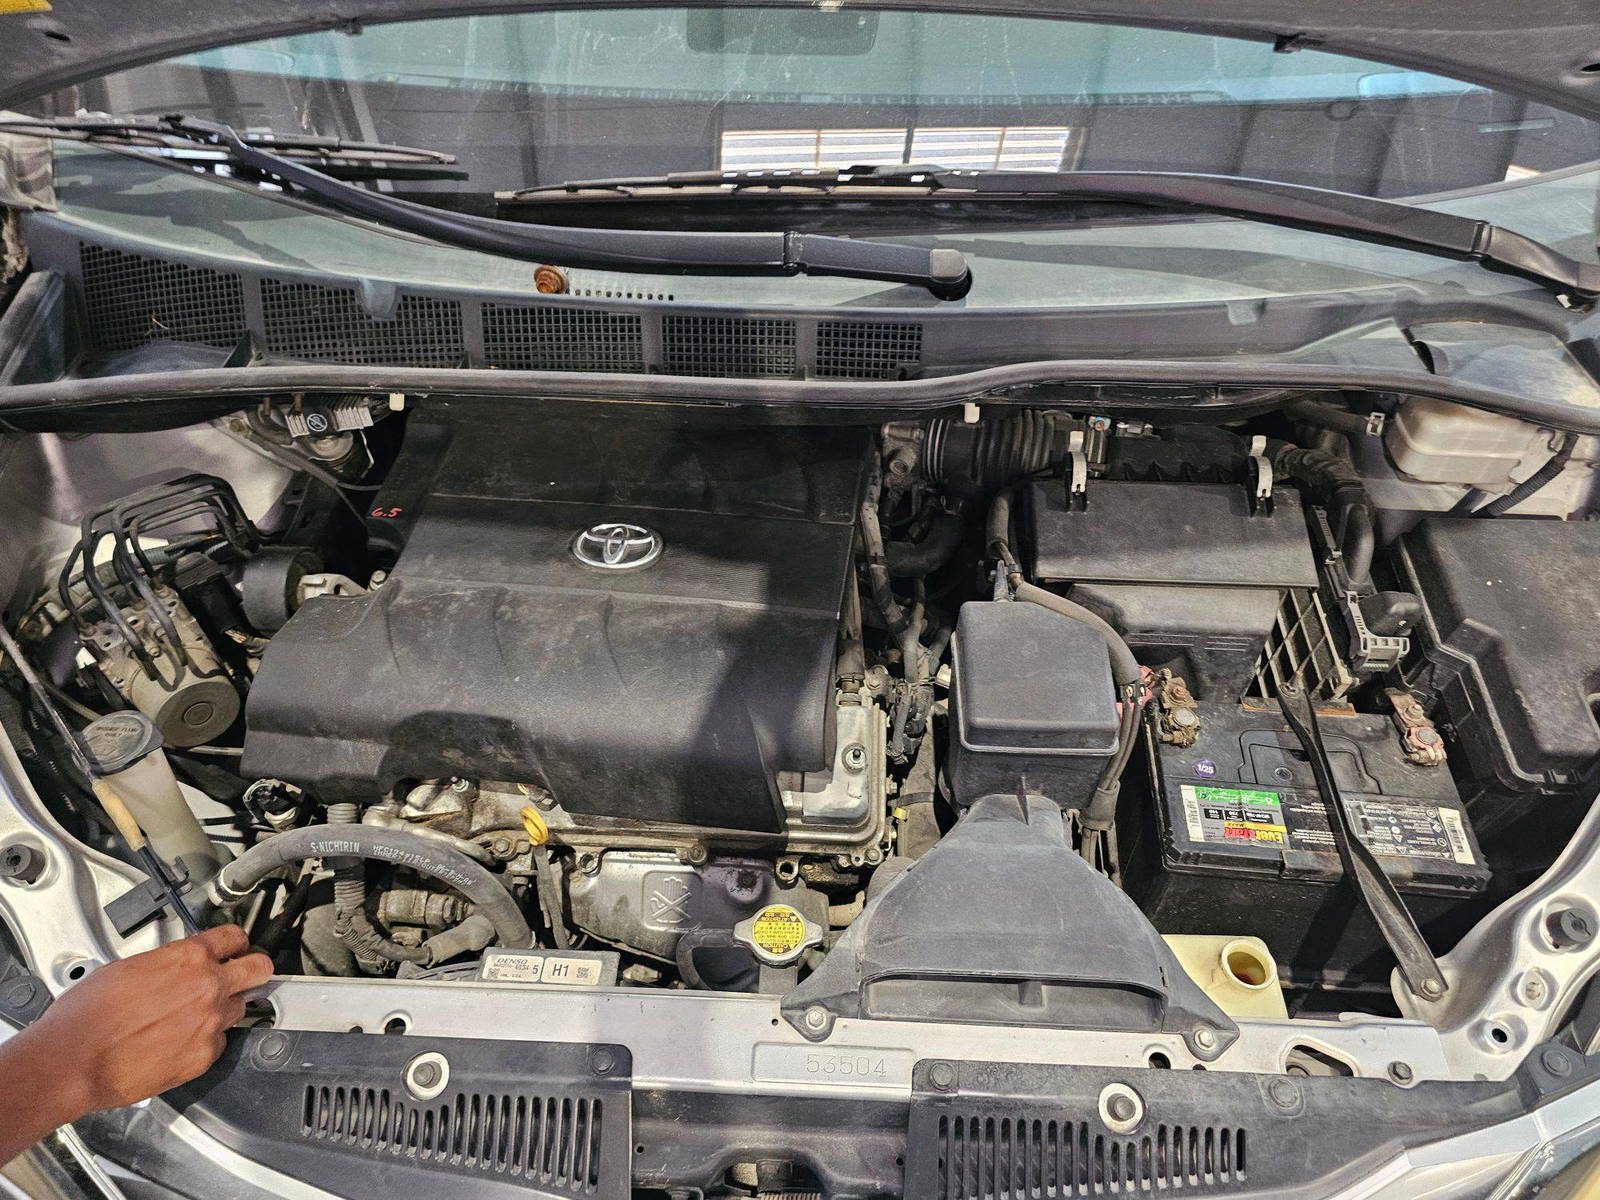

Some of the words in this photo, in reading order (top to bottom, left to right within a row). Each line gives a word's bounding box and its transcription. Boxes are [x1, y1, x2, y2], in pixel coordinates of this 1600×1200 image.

[371, 507, 402, 518] 6.5
[1198, 763, 1214, 774] 1/25
[532, 964, 540, 975] 5
[552, 963, 569, 977] H1
[806, 1053, 887, 1077] 53504
